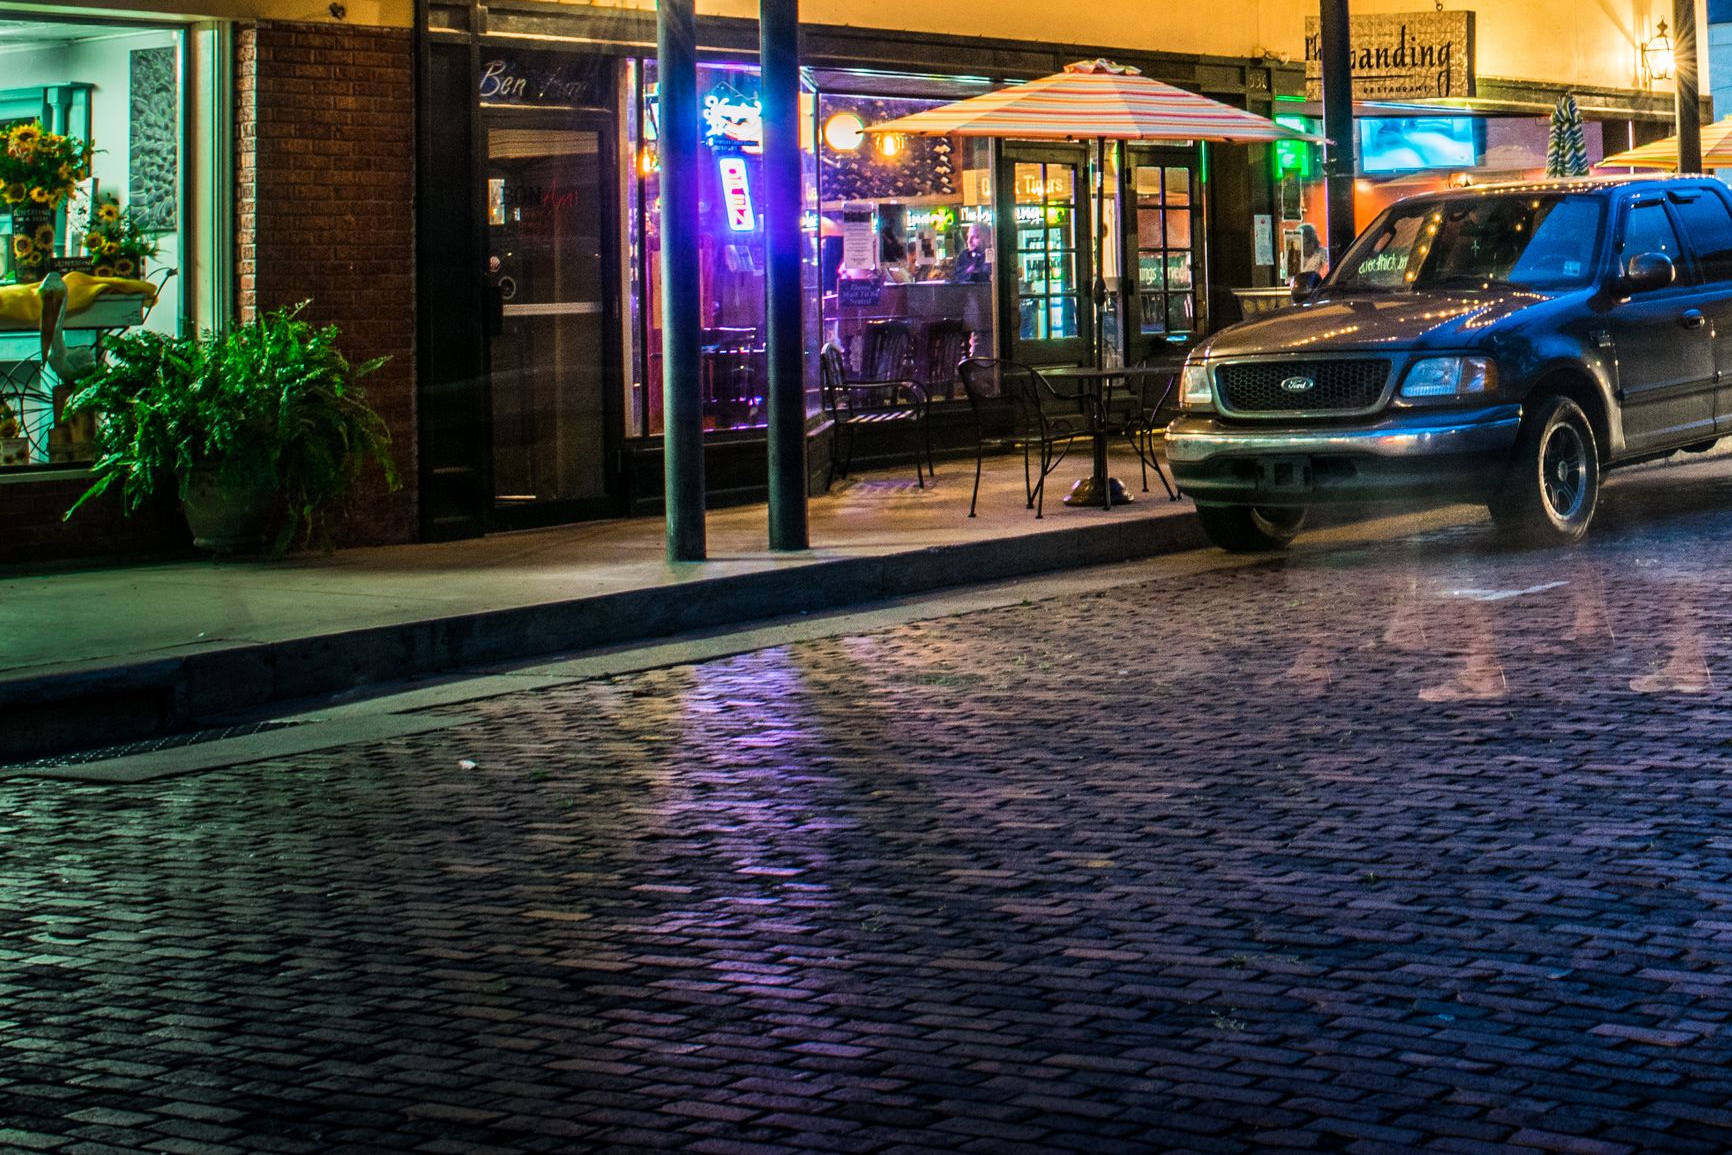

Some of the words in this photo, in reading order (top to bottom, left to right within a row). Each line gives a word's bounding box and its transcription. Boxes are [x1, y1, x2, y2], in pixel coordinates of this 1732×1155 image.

[1305, 32, 1323, 61] Th
[1363, 85, 1429, 94] RESTAURANT
[723, 162, 750, 227] OPEN
